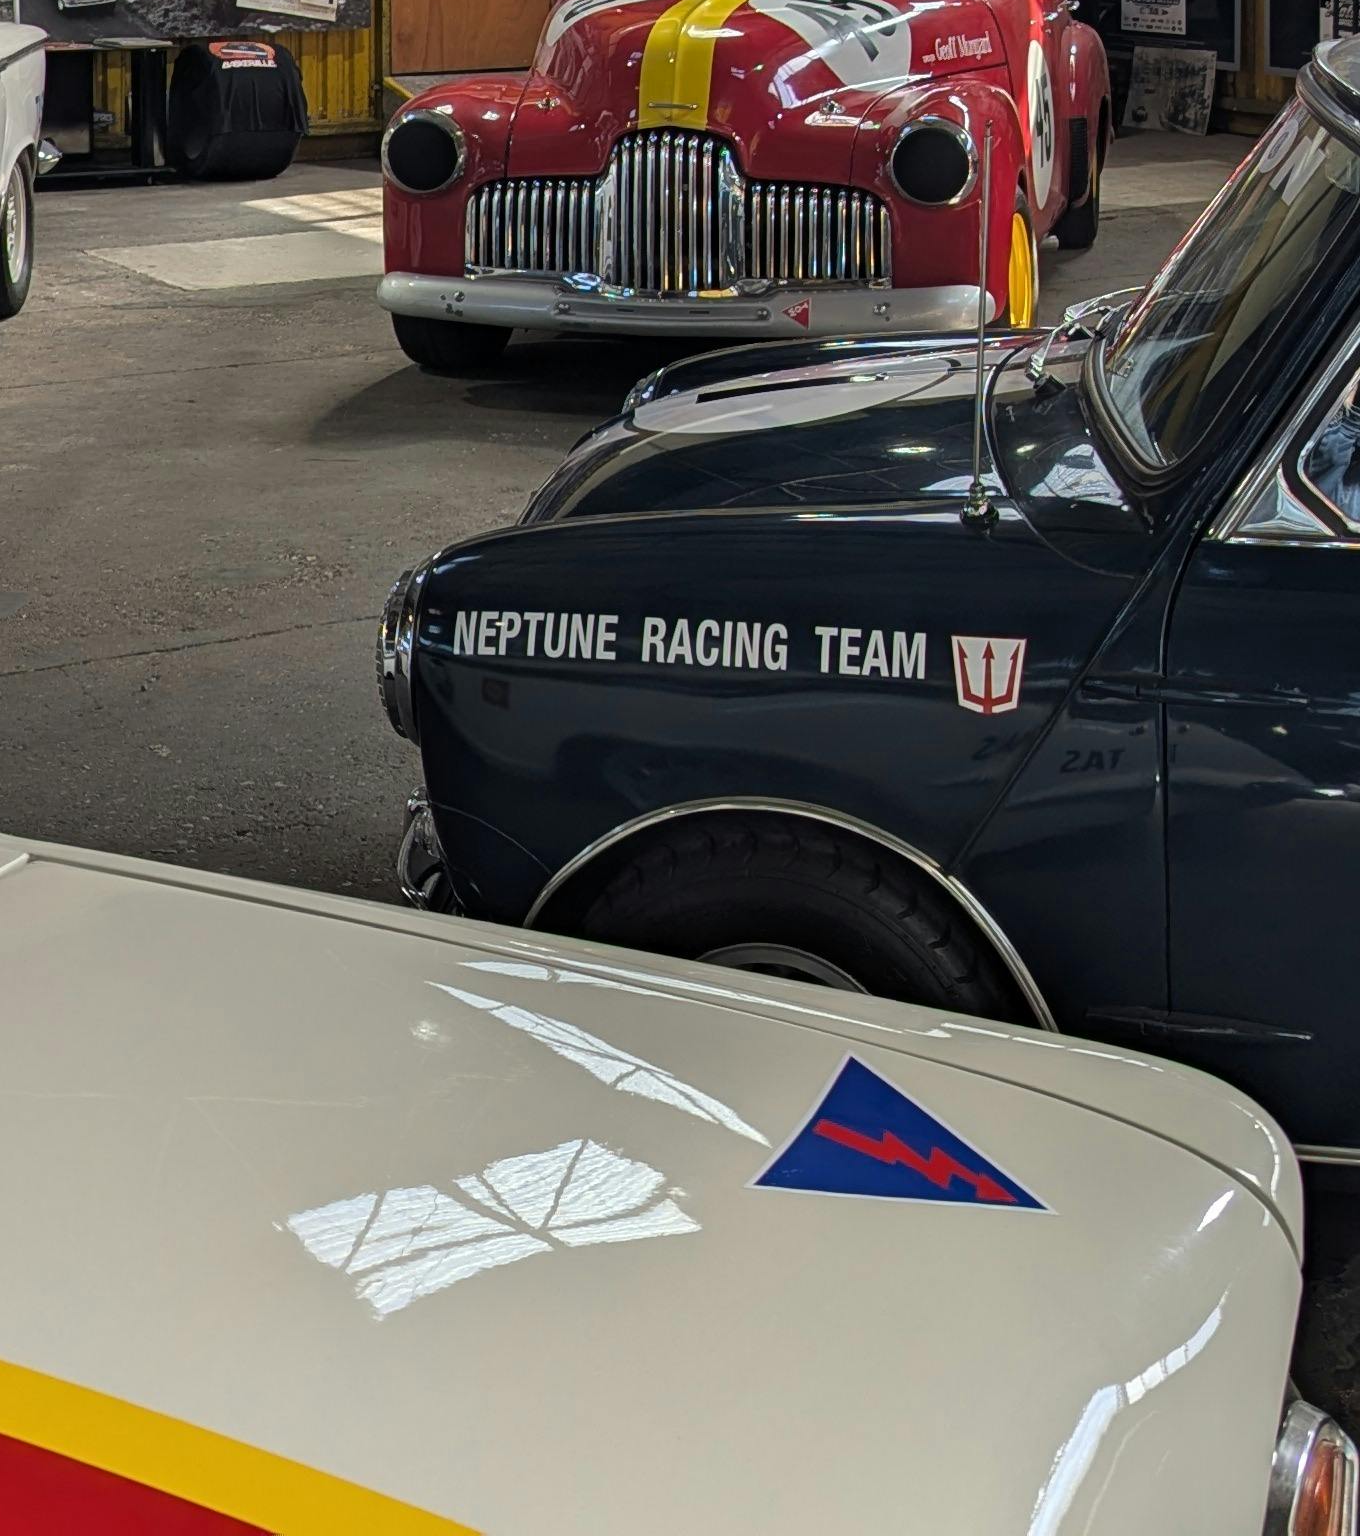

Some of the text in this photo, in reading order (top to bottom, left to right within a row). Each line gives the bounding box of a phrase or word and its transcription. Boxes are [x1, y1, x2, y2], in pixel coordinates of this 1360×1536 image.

[1035, 73, 1052, 168] 45
[453, 611, 927, 679] NEPTUNE RACING TEAM
